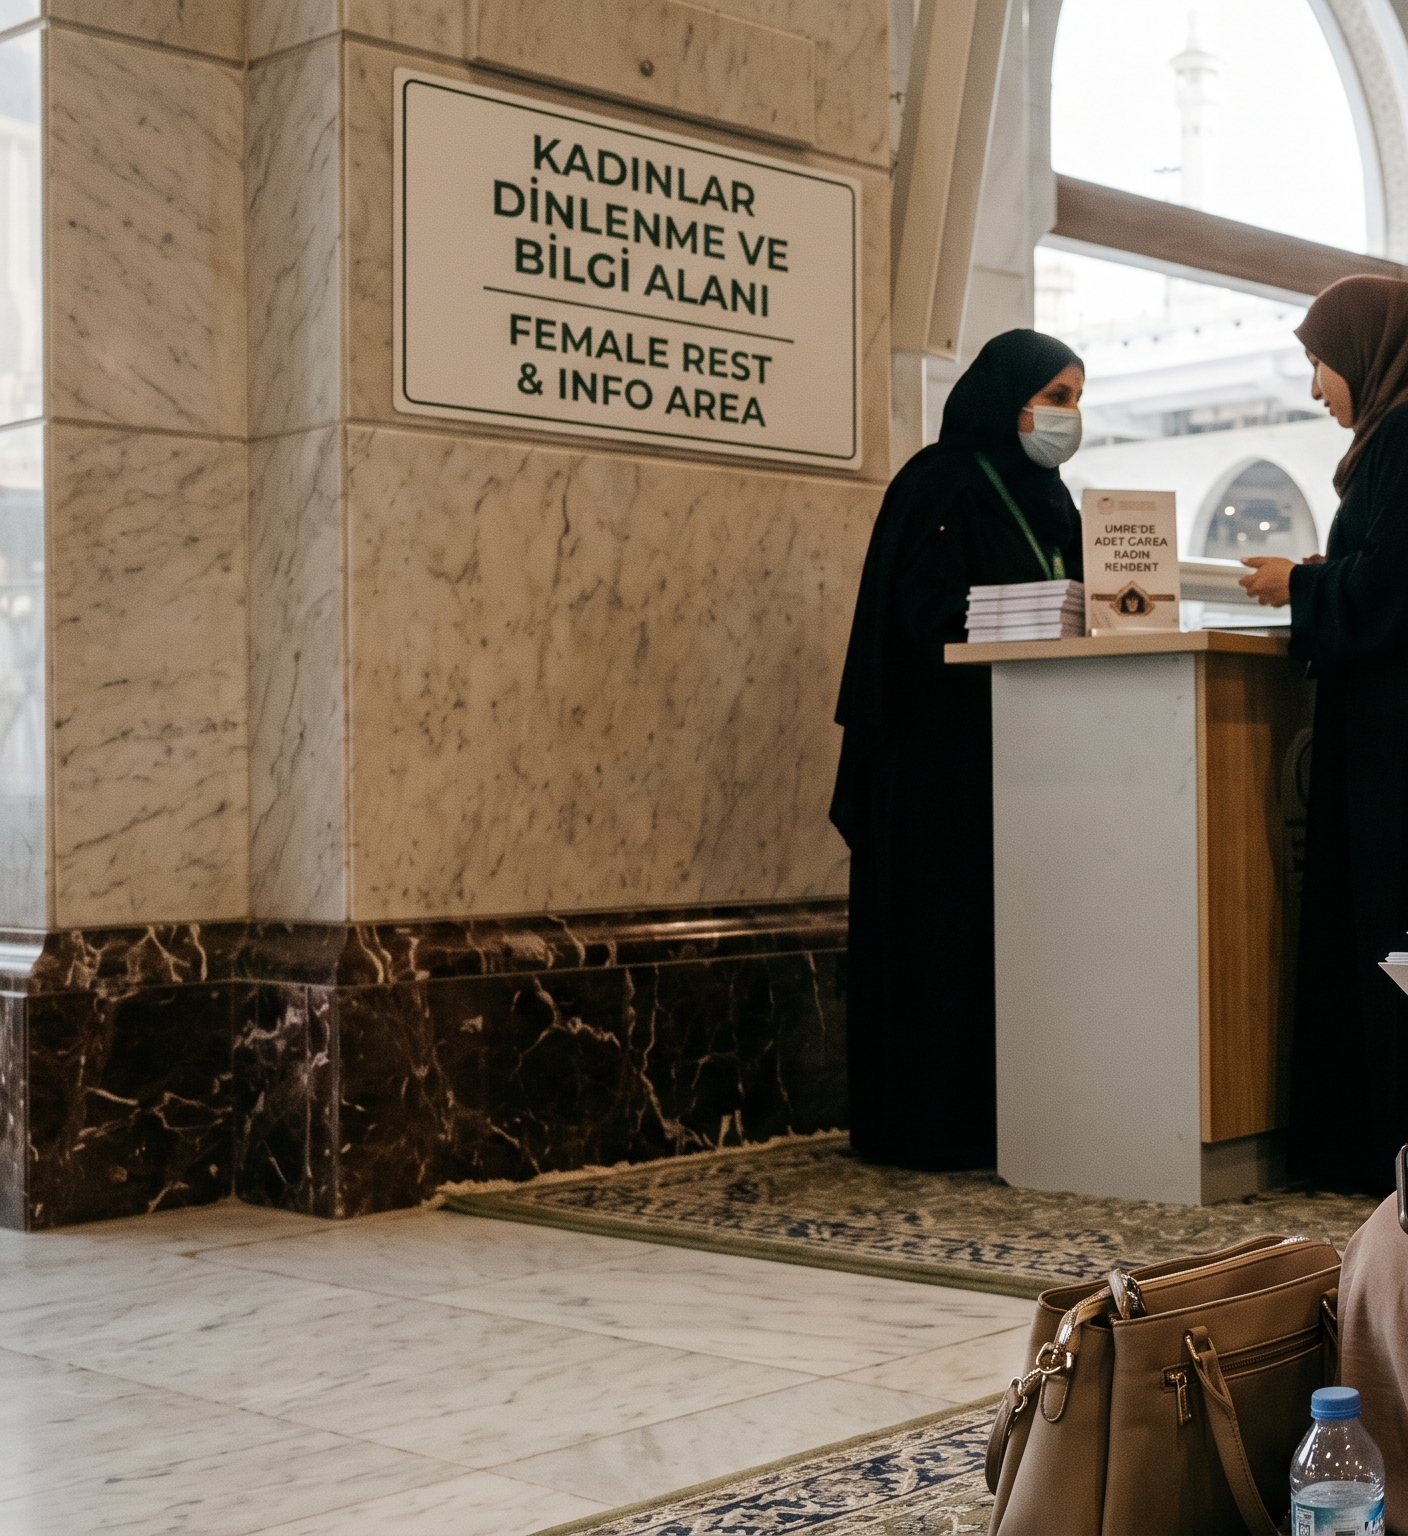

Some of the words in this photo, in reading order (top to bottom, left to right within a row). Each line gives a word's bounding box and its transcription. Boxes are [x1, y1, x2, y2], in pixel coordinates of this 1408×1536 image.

[532, 134, 755, 217] KADINLAR
[493, 176, 725, 260] DİNLENME
[738, 231, 789, 273] VE
[514, 233, 630, 292] BİLGİ
[643, 264, 769, 318] ALANI
[509, 313, 669, 368] FEMALE
[682, 342, 772, 384] REST
[516, 362, 543, 396] &
[558, 367, 653, 410] INFO
[665, 385, 767, 428] AREA
[1094, 537, 1125, 546] ADET
